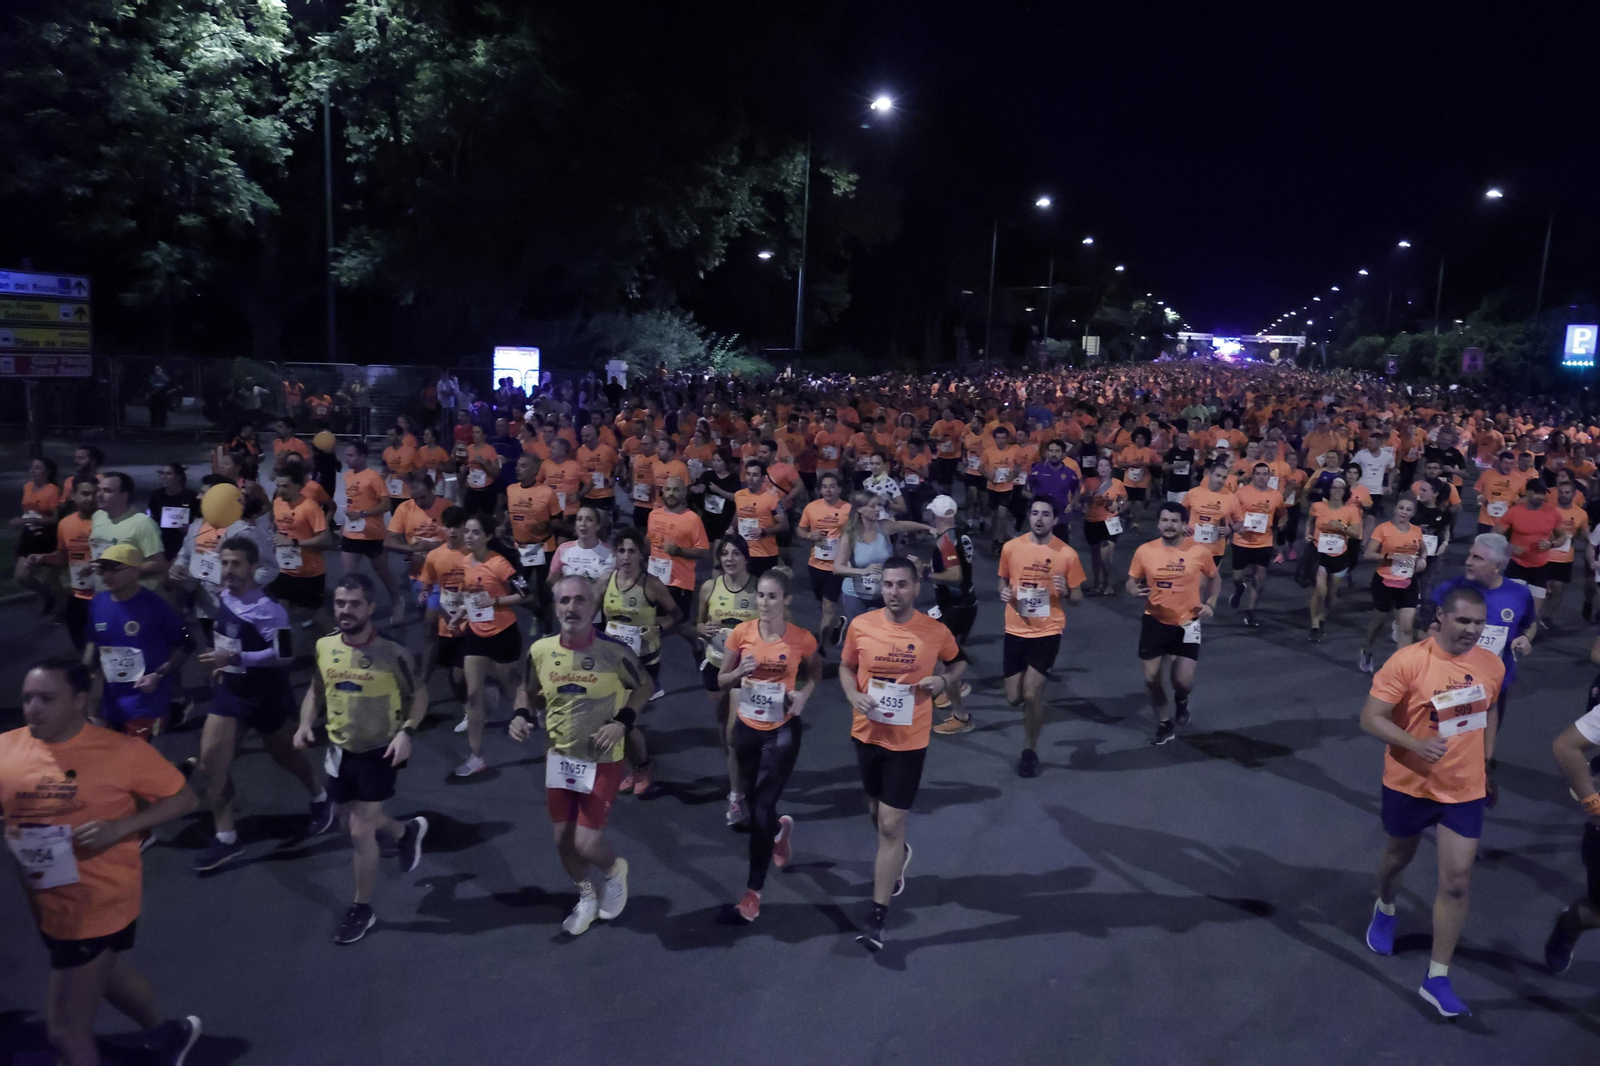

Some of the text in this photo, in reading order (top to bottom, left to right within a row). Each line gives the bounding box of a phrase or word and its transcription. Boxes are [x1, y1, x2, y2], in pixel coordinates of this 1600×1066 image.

[1573, 328, 1592, 352] P
[1479, 636, 1496, 646] 737
[874, 655, 900, 663] SEVILLA
[750, 693, 773, 706] 4534
[879, 696, 903, 709] 4535
[1454, 704, 1473, 717] 509
[560, 761, 588, 775] 17057
